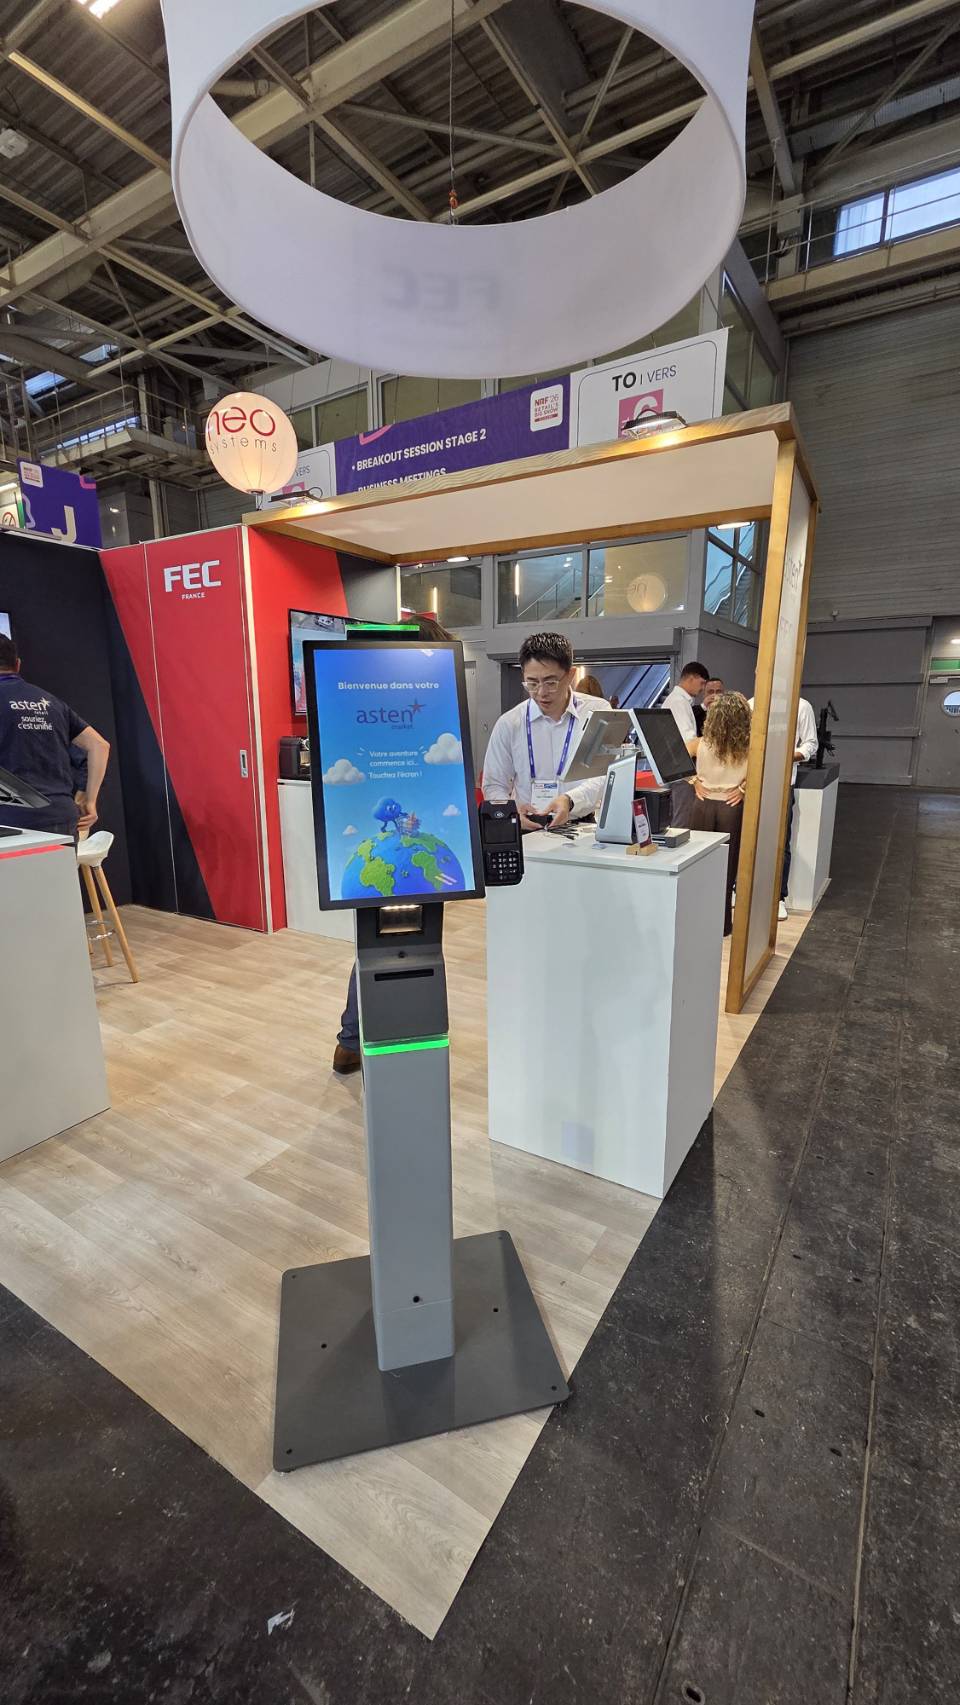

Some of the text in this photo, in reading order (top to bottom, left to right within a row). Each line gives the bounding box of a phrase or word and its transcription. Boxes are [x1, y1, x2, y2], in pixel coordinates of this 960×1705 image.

[612, 365, 676, 391] TO VERS
[207, 407, 276, 442] neo
[210, 437, 277, 455] systems
[356, 428, 486, 471] BREAKOUT SESSION STAGE 2
[51, 505, 77, 543] J
[163, 560, 221, 592] FEC
[181, 592, 206, 600] FRANCE
[338, 681, 439, 690] Bienvenue dans votre
[9, 700, 47, 711] asten
[356, 707, 414, 724] asten
